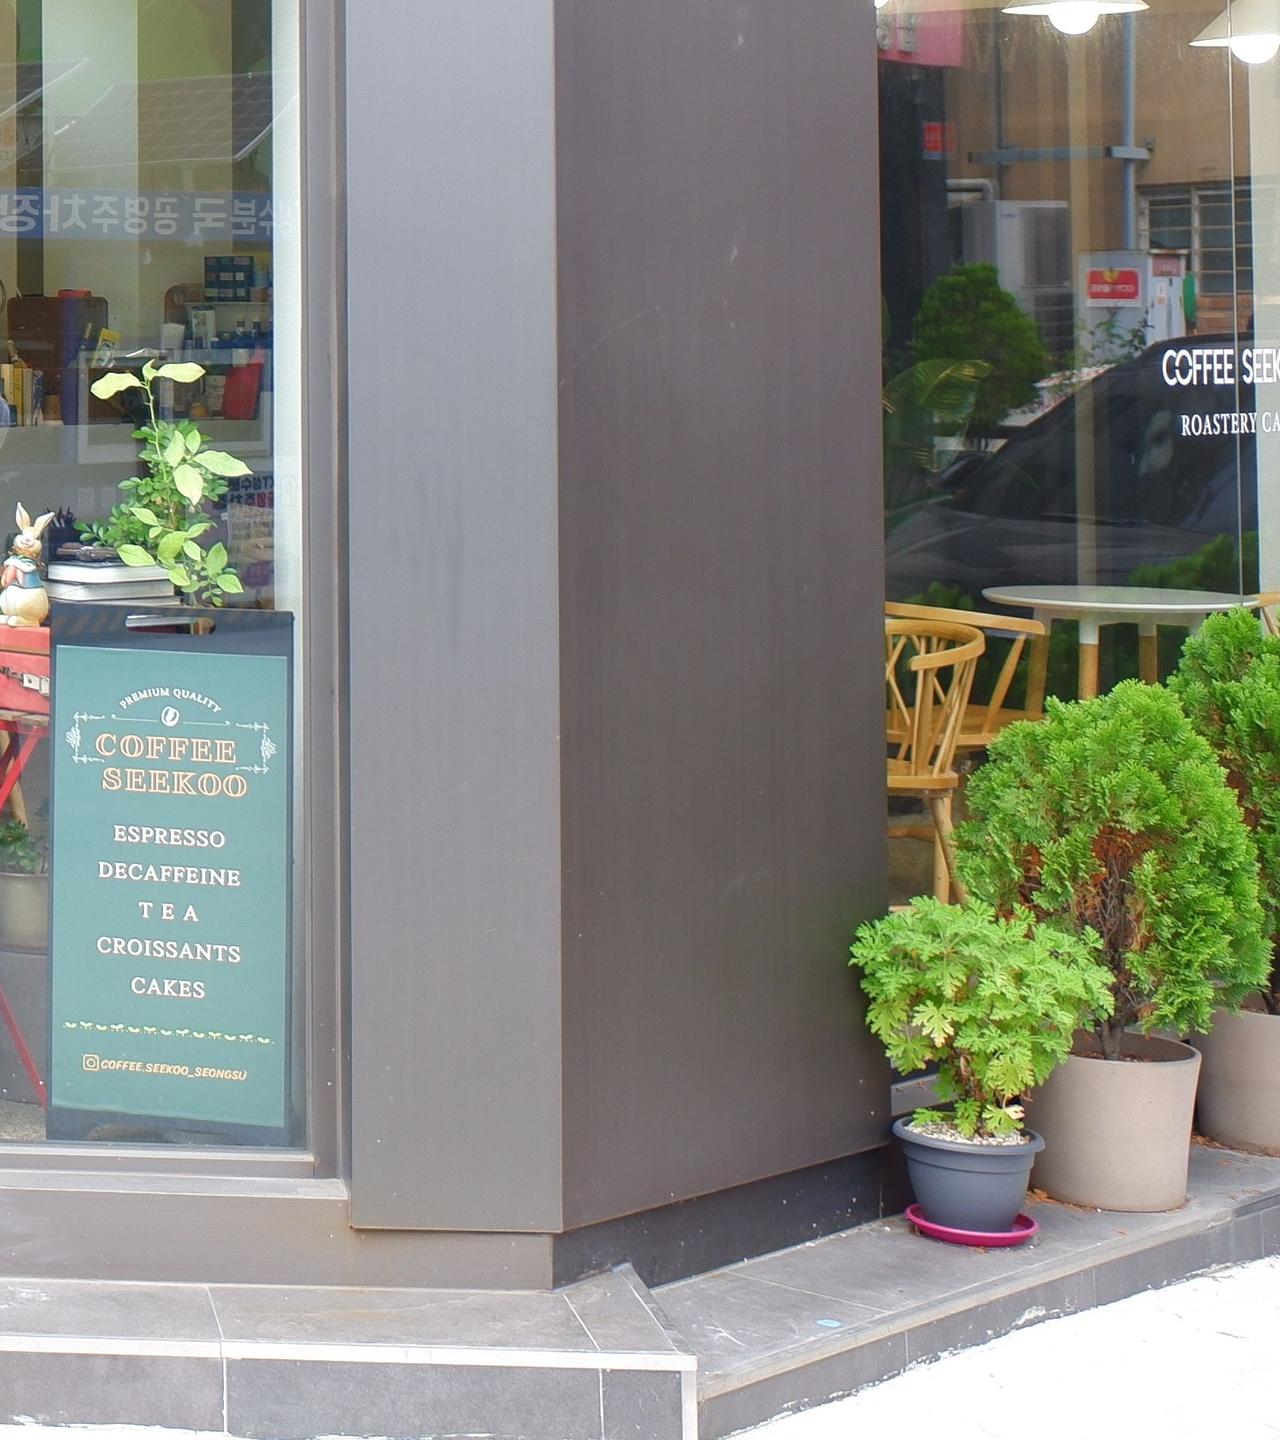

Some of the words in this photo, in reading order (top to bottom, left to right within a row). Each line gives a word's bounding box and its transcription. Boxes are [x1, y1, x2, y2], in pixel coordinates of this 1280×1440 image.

[1162, 348, 1236, 386] COFFEE
[1181, 412, 1258, 436] ROASTERY
[119, 687, 172, 710] PREMIUM
[172, 687, 224, 713] QUALITY
[95, 732, 237, 765] COFFEE
[101, 766, 248, 798] SEEKOO
[113, 824, 226, 849] ESPRESSO
[97, 860, 241, 887] DECAFFEINE
[96, 935, 241, 963] CROISSANTS
[130, 976, 206, 1000] CAKES
